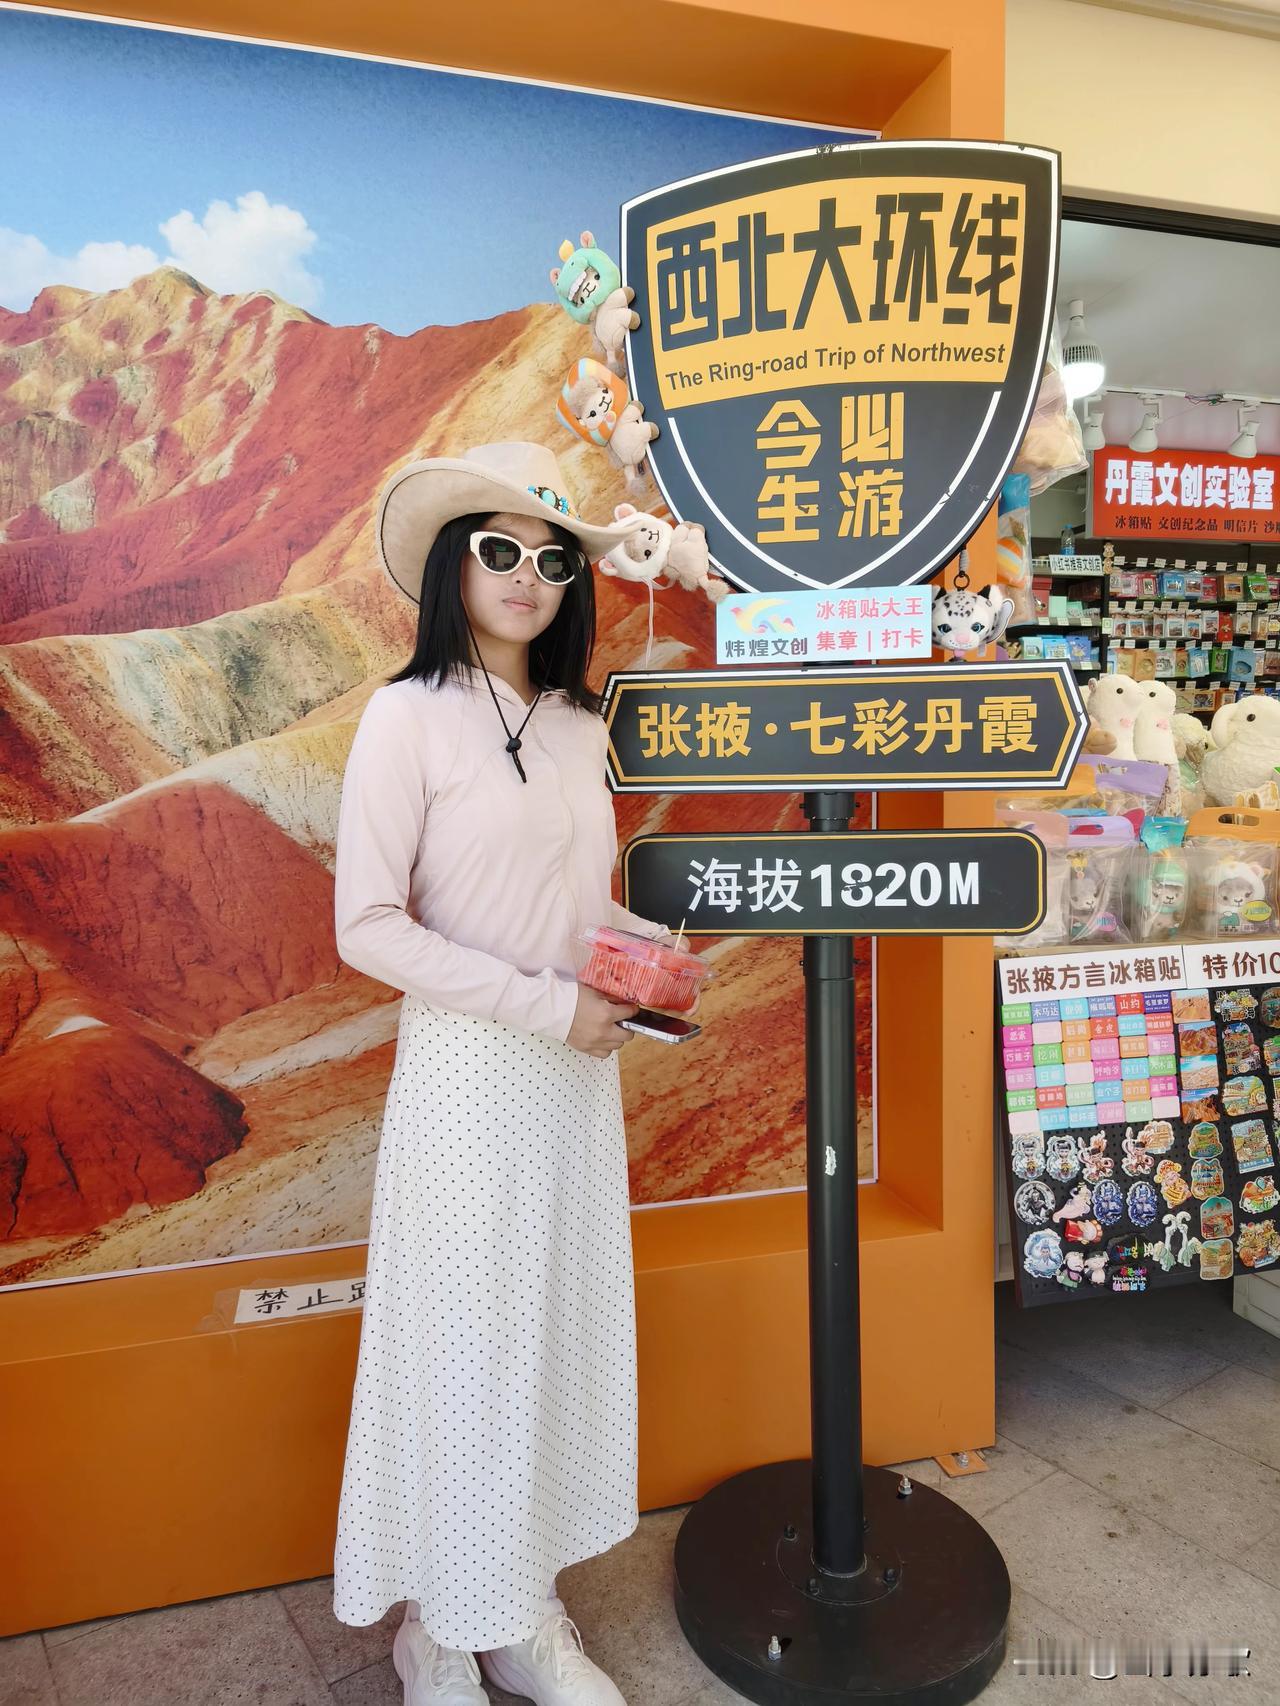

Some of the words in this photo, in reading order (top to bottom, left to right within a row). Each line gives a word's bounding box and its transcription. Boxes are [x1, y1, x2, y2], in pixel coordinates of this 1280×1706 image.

[656, 192, 1020, 352] 西北大环线
[665, 371, 703, 391] The
[709, 350, 808, 382] Ring-road
[815, 344, 856, 369] Trip
[863, 344, 884, 363] of
[892, 342, 1005, 364] Northwest
[1105, 459, 1275, 510] 丹霞文创实验室
[1115, 515, 1151, 530] 冰箱贴
[1158, 517, 1218, 531] 文创纪念品
[1223, 519, 1258, 533] 明信片
[816, 597, 924, 620] 冰箱贴大王
[725, 637, 808, 658] 炜煌文创
[637, 695, 1039, 759] 张掖·七彩丹霞
[687, 857, 980, 914] 海拔1820M
[1006, 955, 1181, 995] 张掖方言冰箱贴
